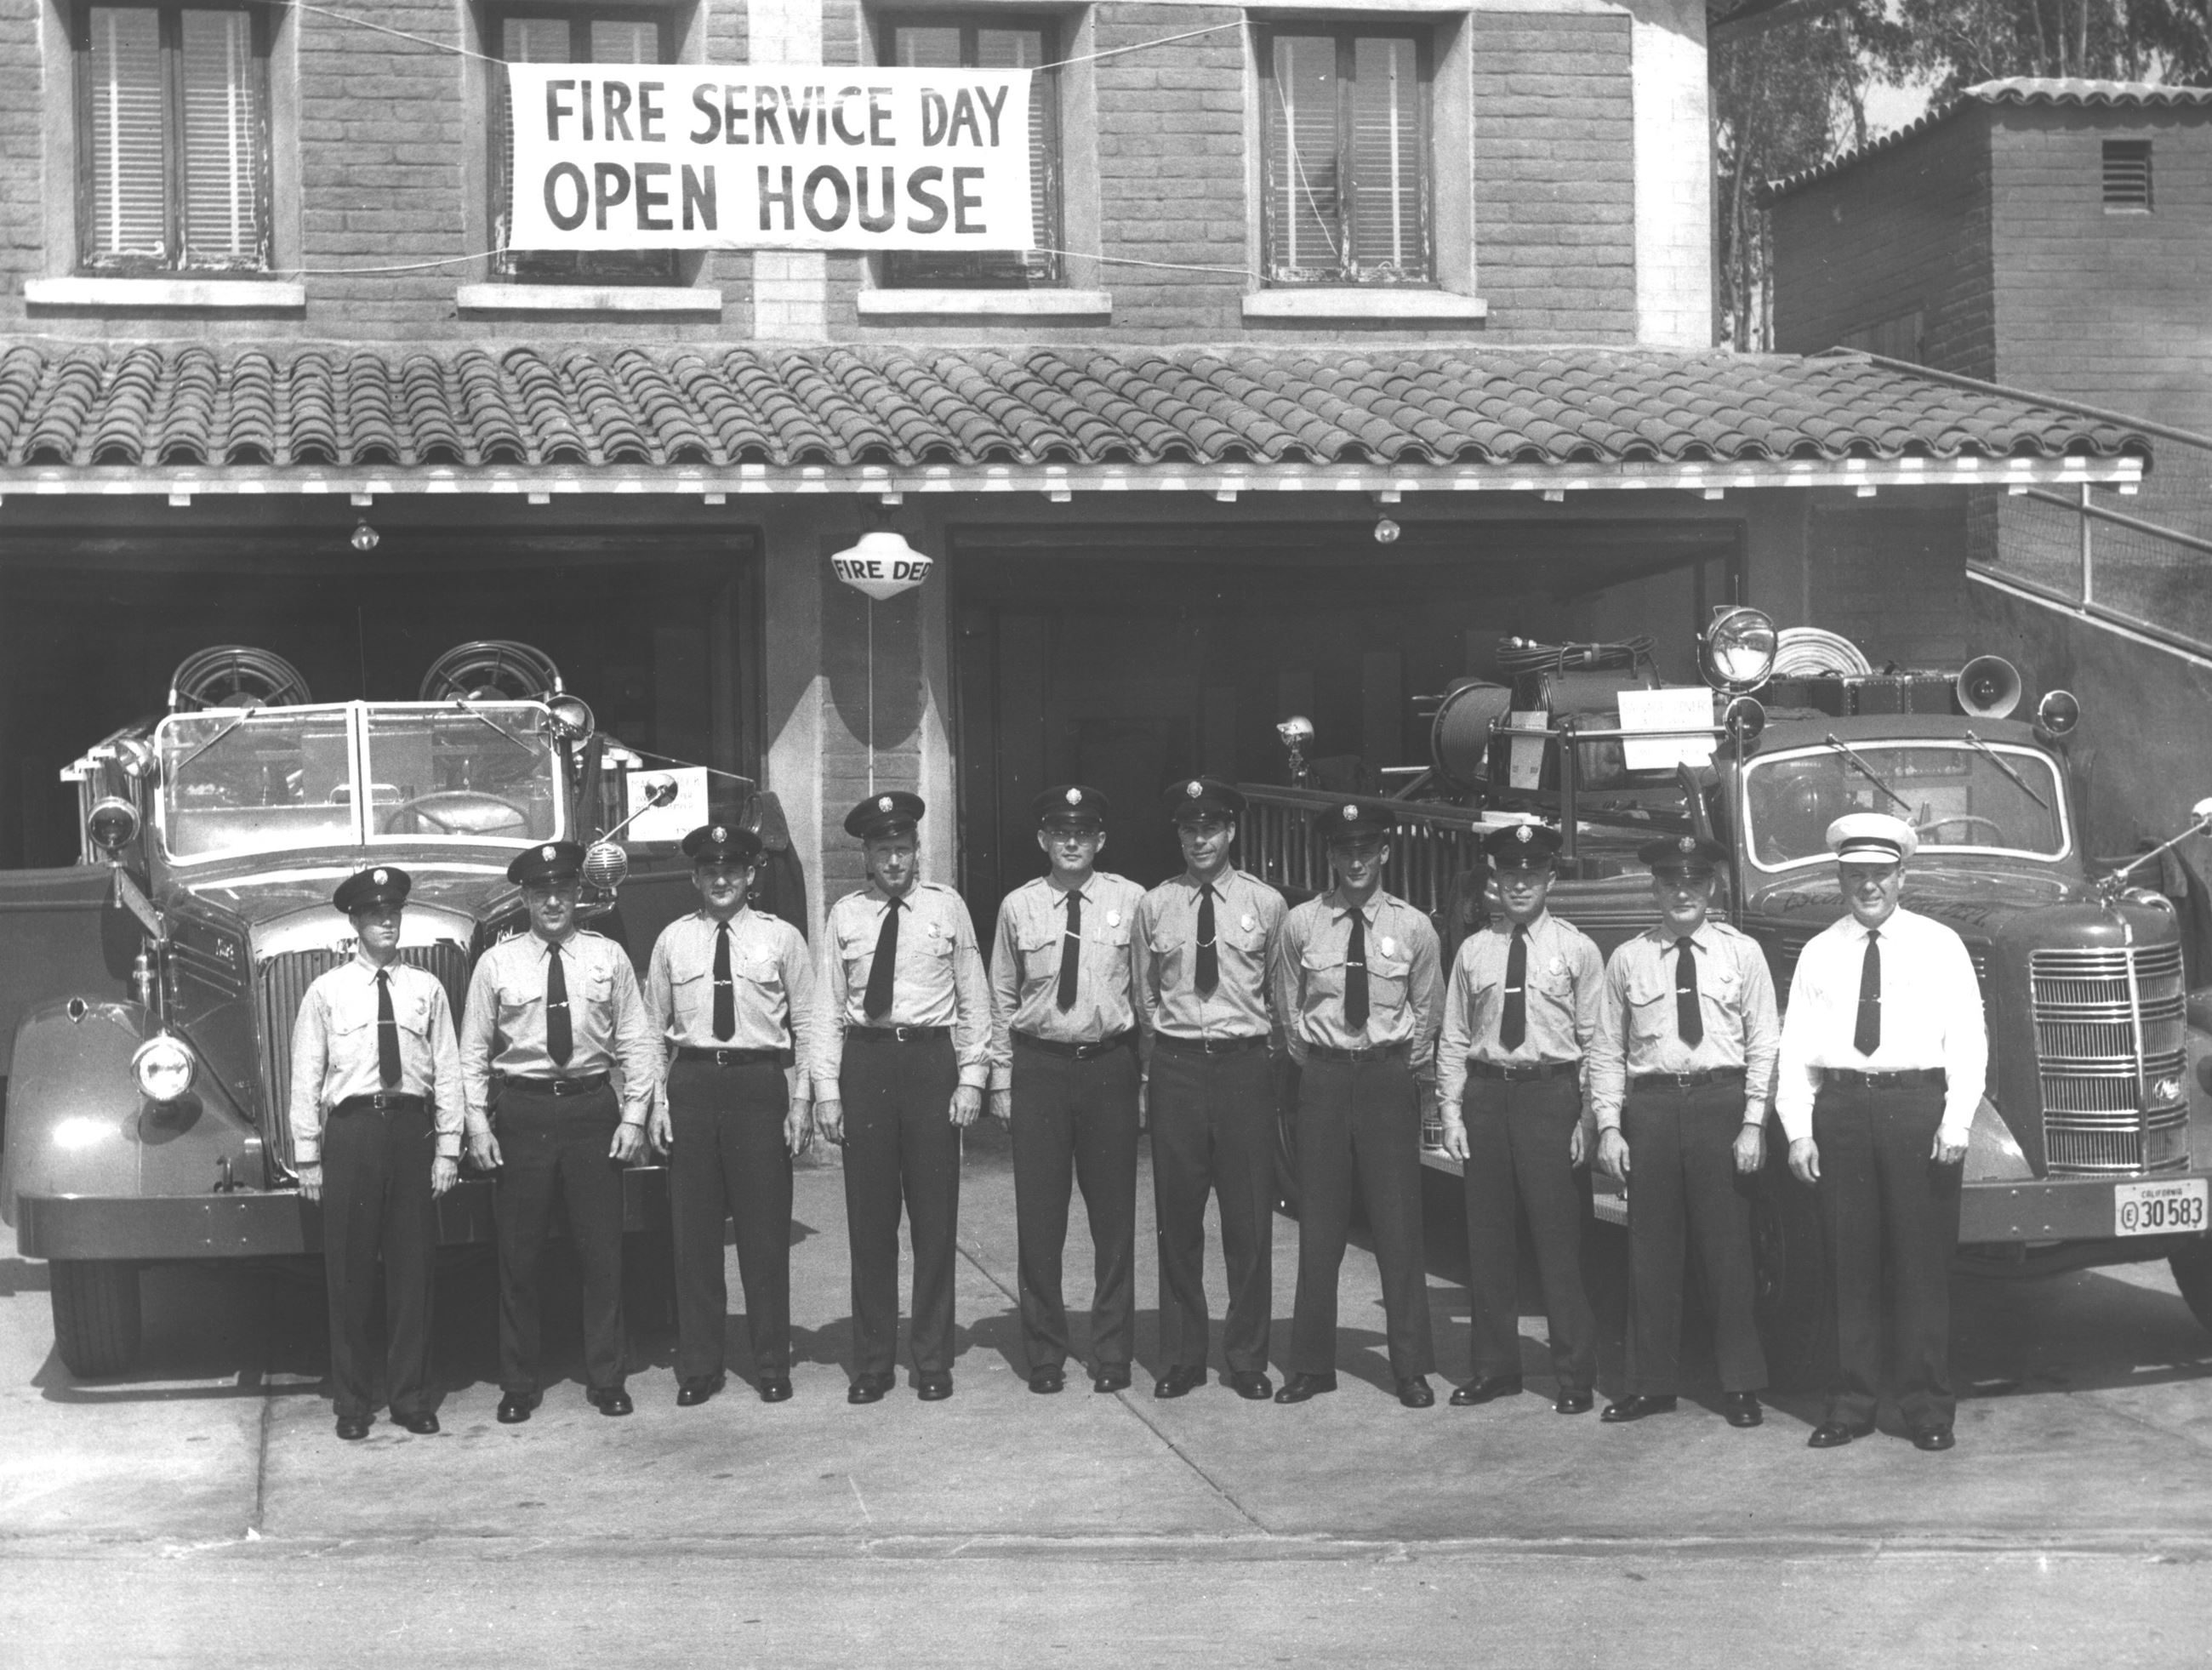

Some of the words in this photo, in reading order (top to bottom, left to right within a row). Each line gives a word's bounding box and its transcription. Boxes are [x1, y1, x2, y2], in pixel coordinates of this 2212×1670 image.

[546, 79, 666, 142] FIRE
[689, 83, 897, 146] SERVICE
[921, 85, 1009, 147] DAY
[543, 161, 718, 231] OPEN
[757, 164, 987, 235] HOUSE
[833, 559, 884, 579] FIRE
